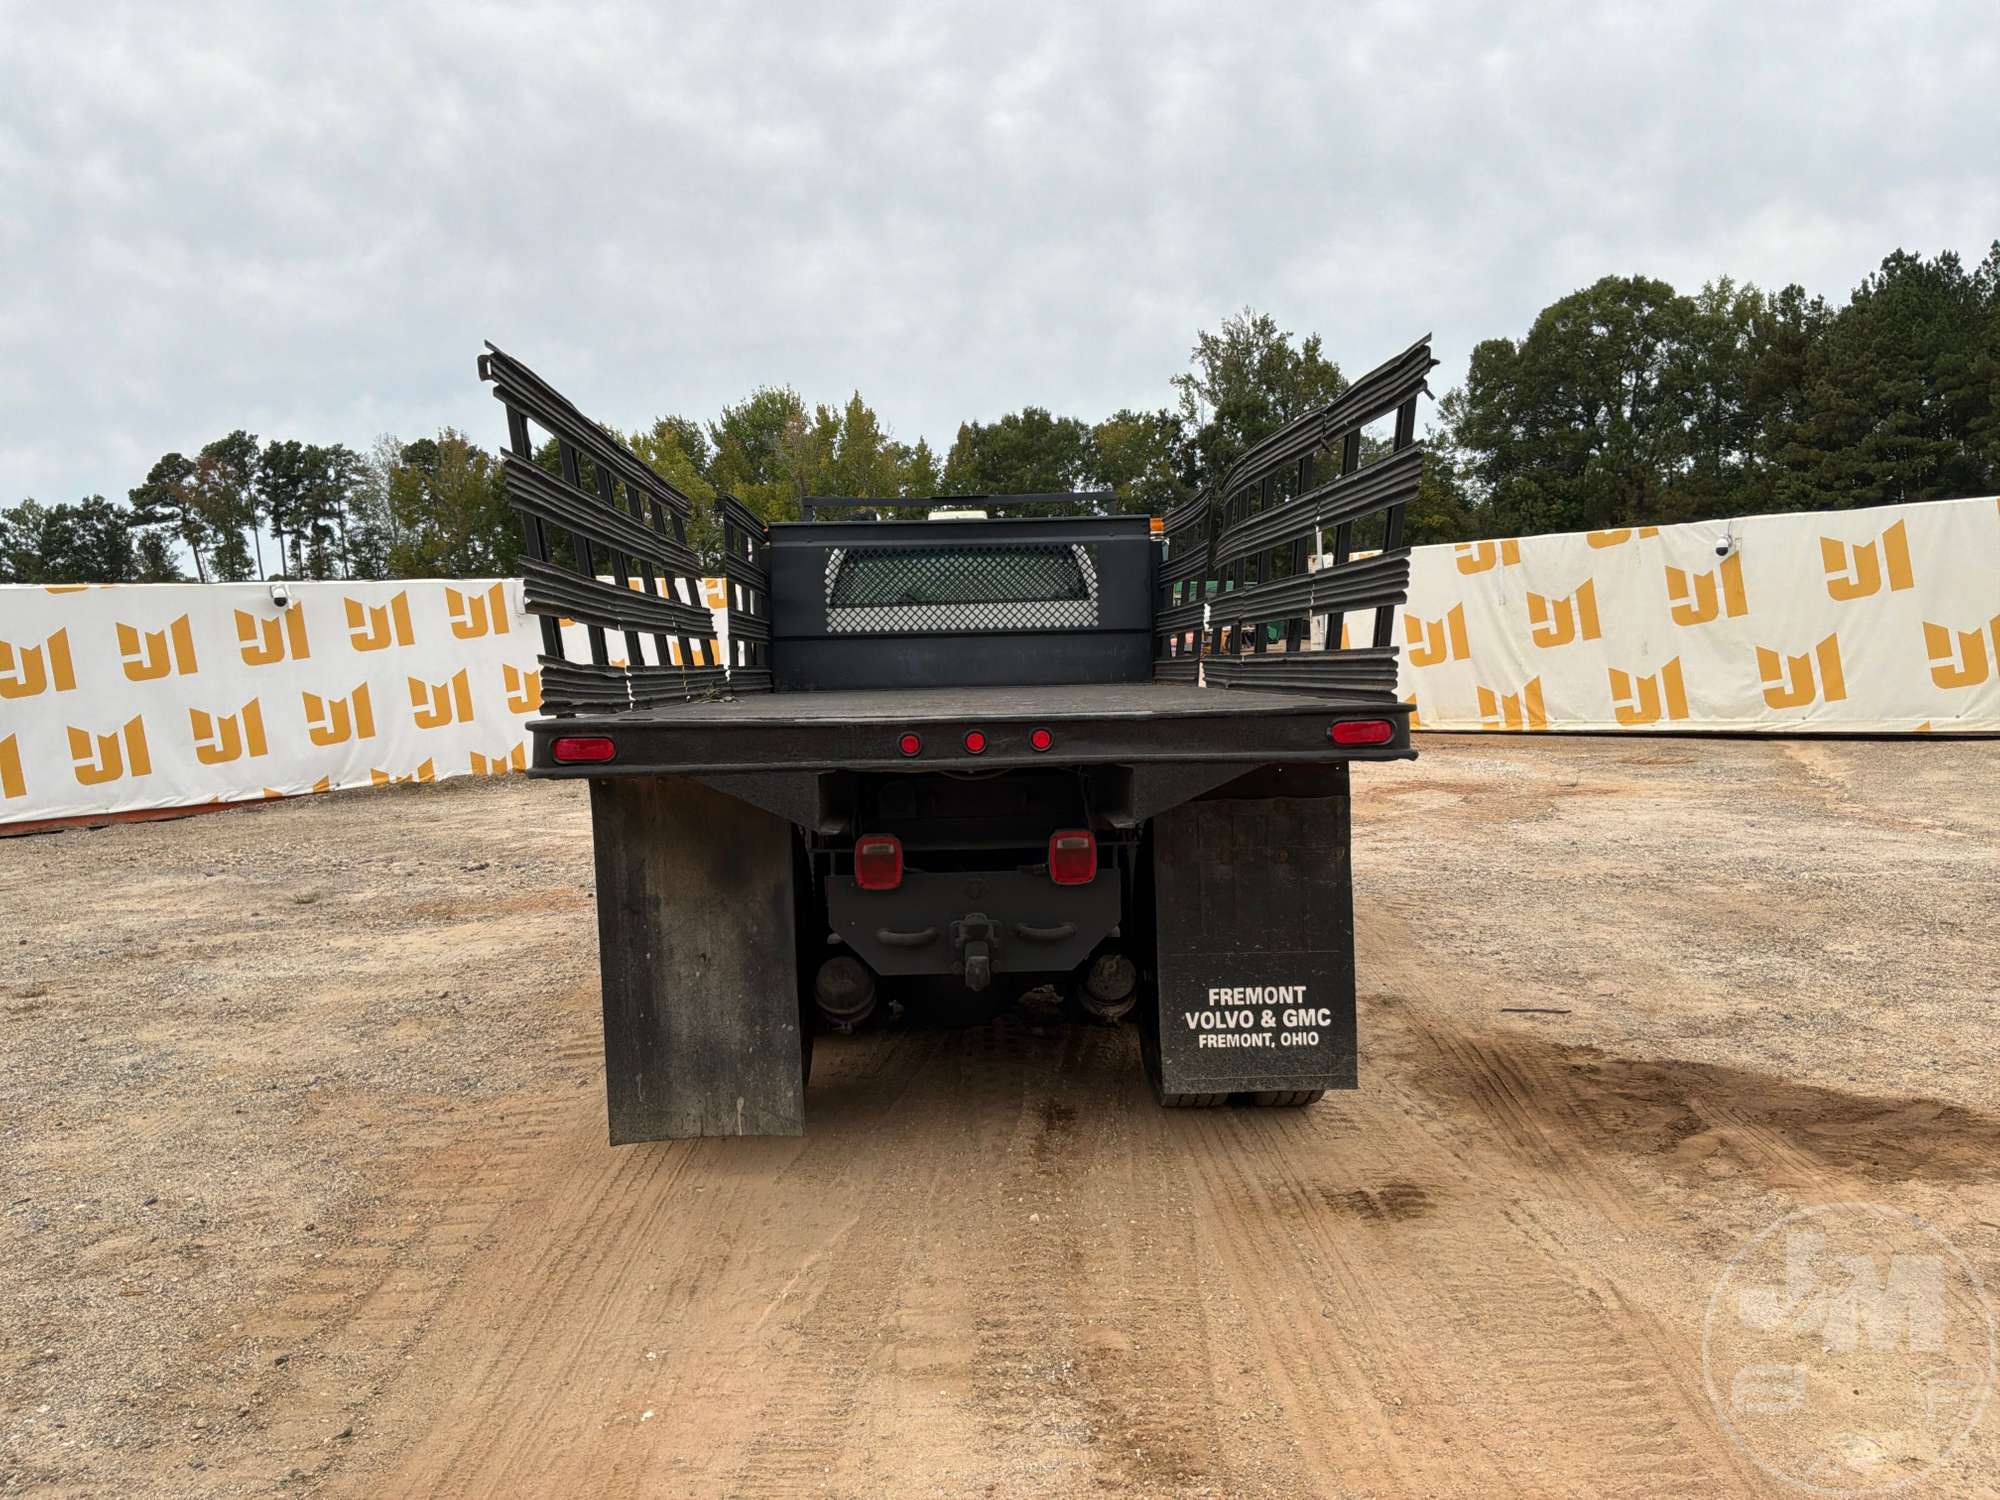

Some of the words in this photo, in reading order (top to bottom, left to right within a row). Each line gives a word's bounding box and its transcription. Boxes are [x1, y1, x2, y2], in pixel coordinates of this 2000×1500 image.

[1208, 986, 1306, 1006] FREMONT
[1185, 1011, 1254, 1030] VOLVO
[1260, 1009, 1276, 1028] &
[1282, 1008, 1332, 1028] GMC
[1198, 1032, 1276, 1049] FREMONT,
[1280, 1031, 1319, 1047] OHIO
